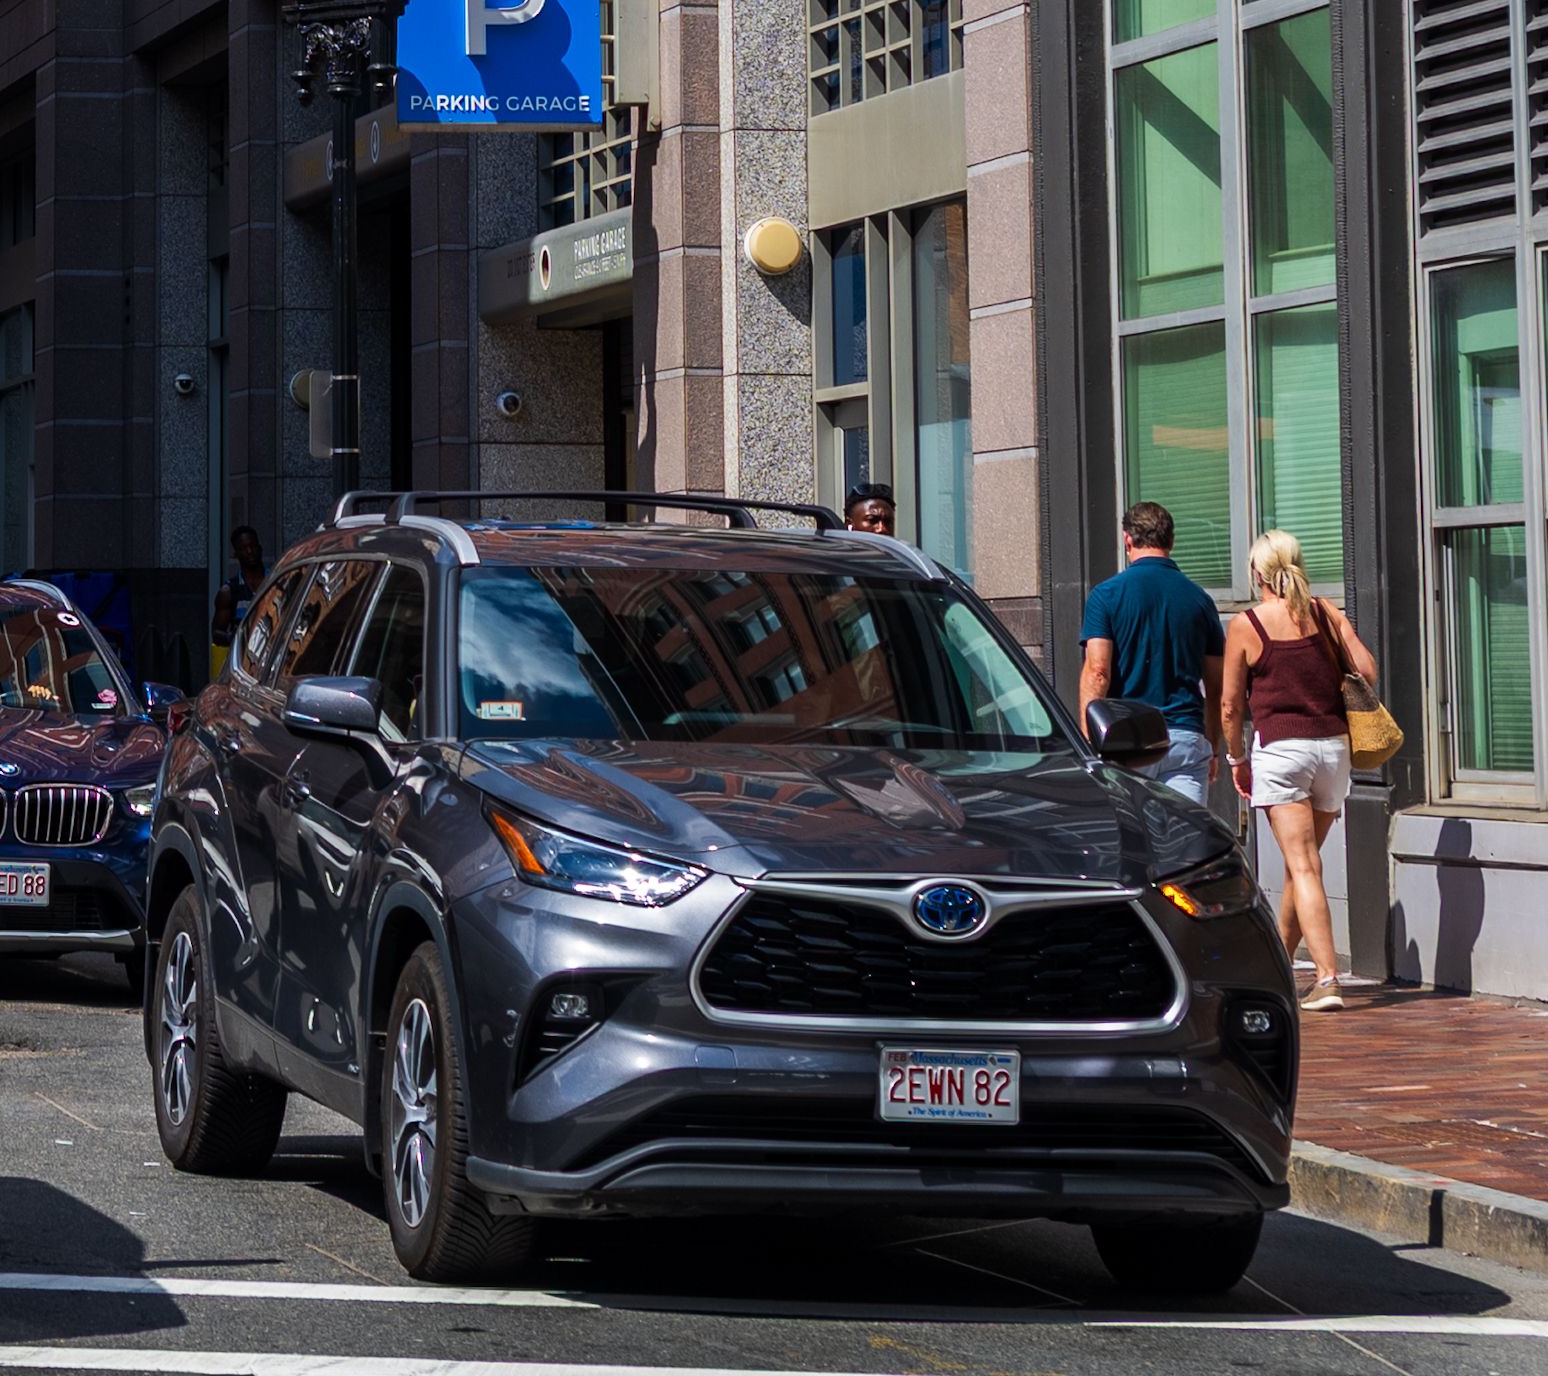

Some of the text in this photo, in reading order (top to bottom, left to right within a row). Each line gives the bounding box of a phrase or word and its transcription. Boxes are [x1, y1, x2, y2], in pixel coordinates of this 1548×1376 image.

[410, 95, 590, 112] PARKING GARAGE
[574, 227, 626, 262] PARKING GARAGE
[23, 874, 45, 896] 88
[888, 1051, 988, 1066] FEB Massachusetts
[888, 1065, 1011, 1107] 2EWN 82
